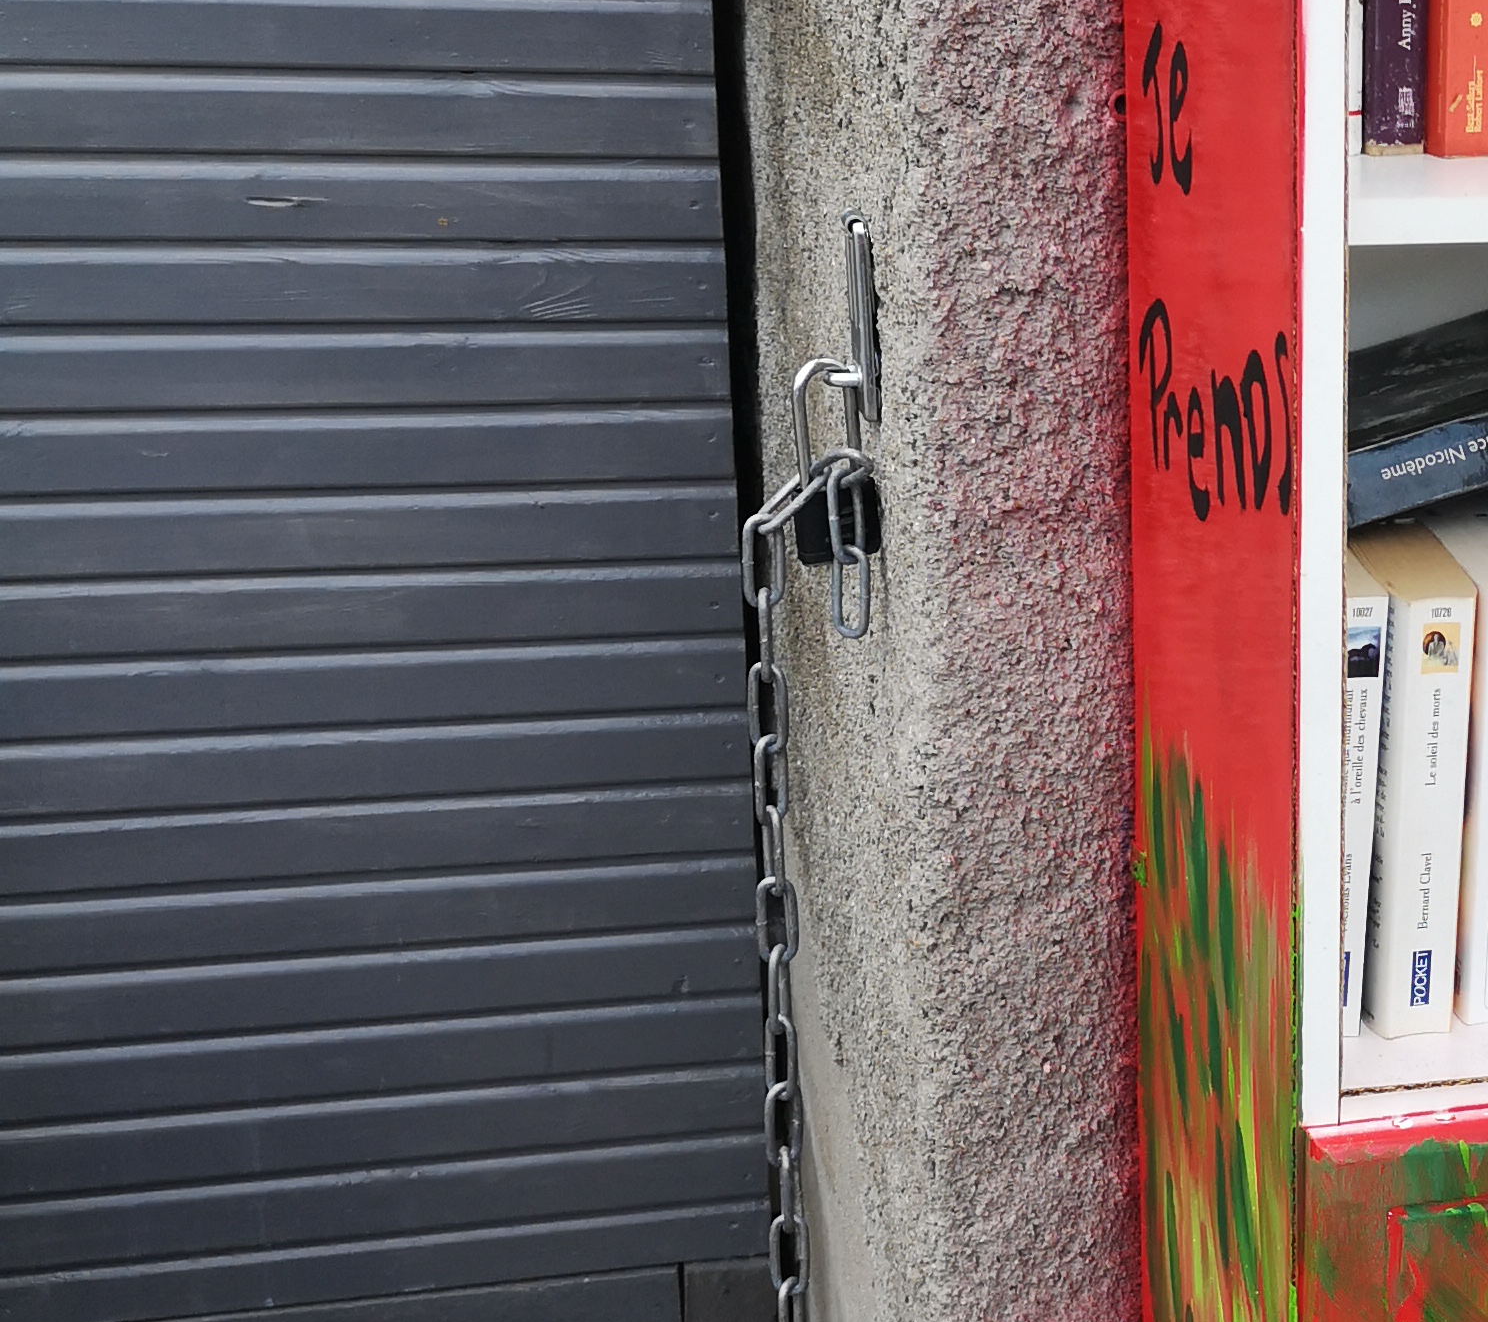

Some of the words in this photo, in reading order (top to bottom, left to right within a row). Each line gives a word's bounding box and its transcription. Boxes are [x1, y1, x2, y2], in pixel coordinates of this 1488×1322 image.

[1398, 10, 1417, 51] Anny
[1380, 446, 1467, 482] Nicodème
[1354, 688, 1368, 731] chevaux
[1430, 688, 1442, 718] morts
[1352, 734, 1365, 752] des
[1427, 720, 1439, 739] des
[1425, 741, 1439, 769] soleil
[1350, 754, 1364, 795] l'oreille
[1424, 772, 1437, 786] Le
[1418, 852, 1433, 885] Clavel
[1416, 888, 1431, 930] Bernard
[1412, 950, 1430, 1006] POCKET
